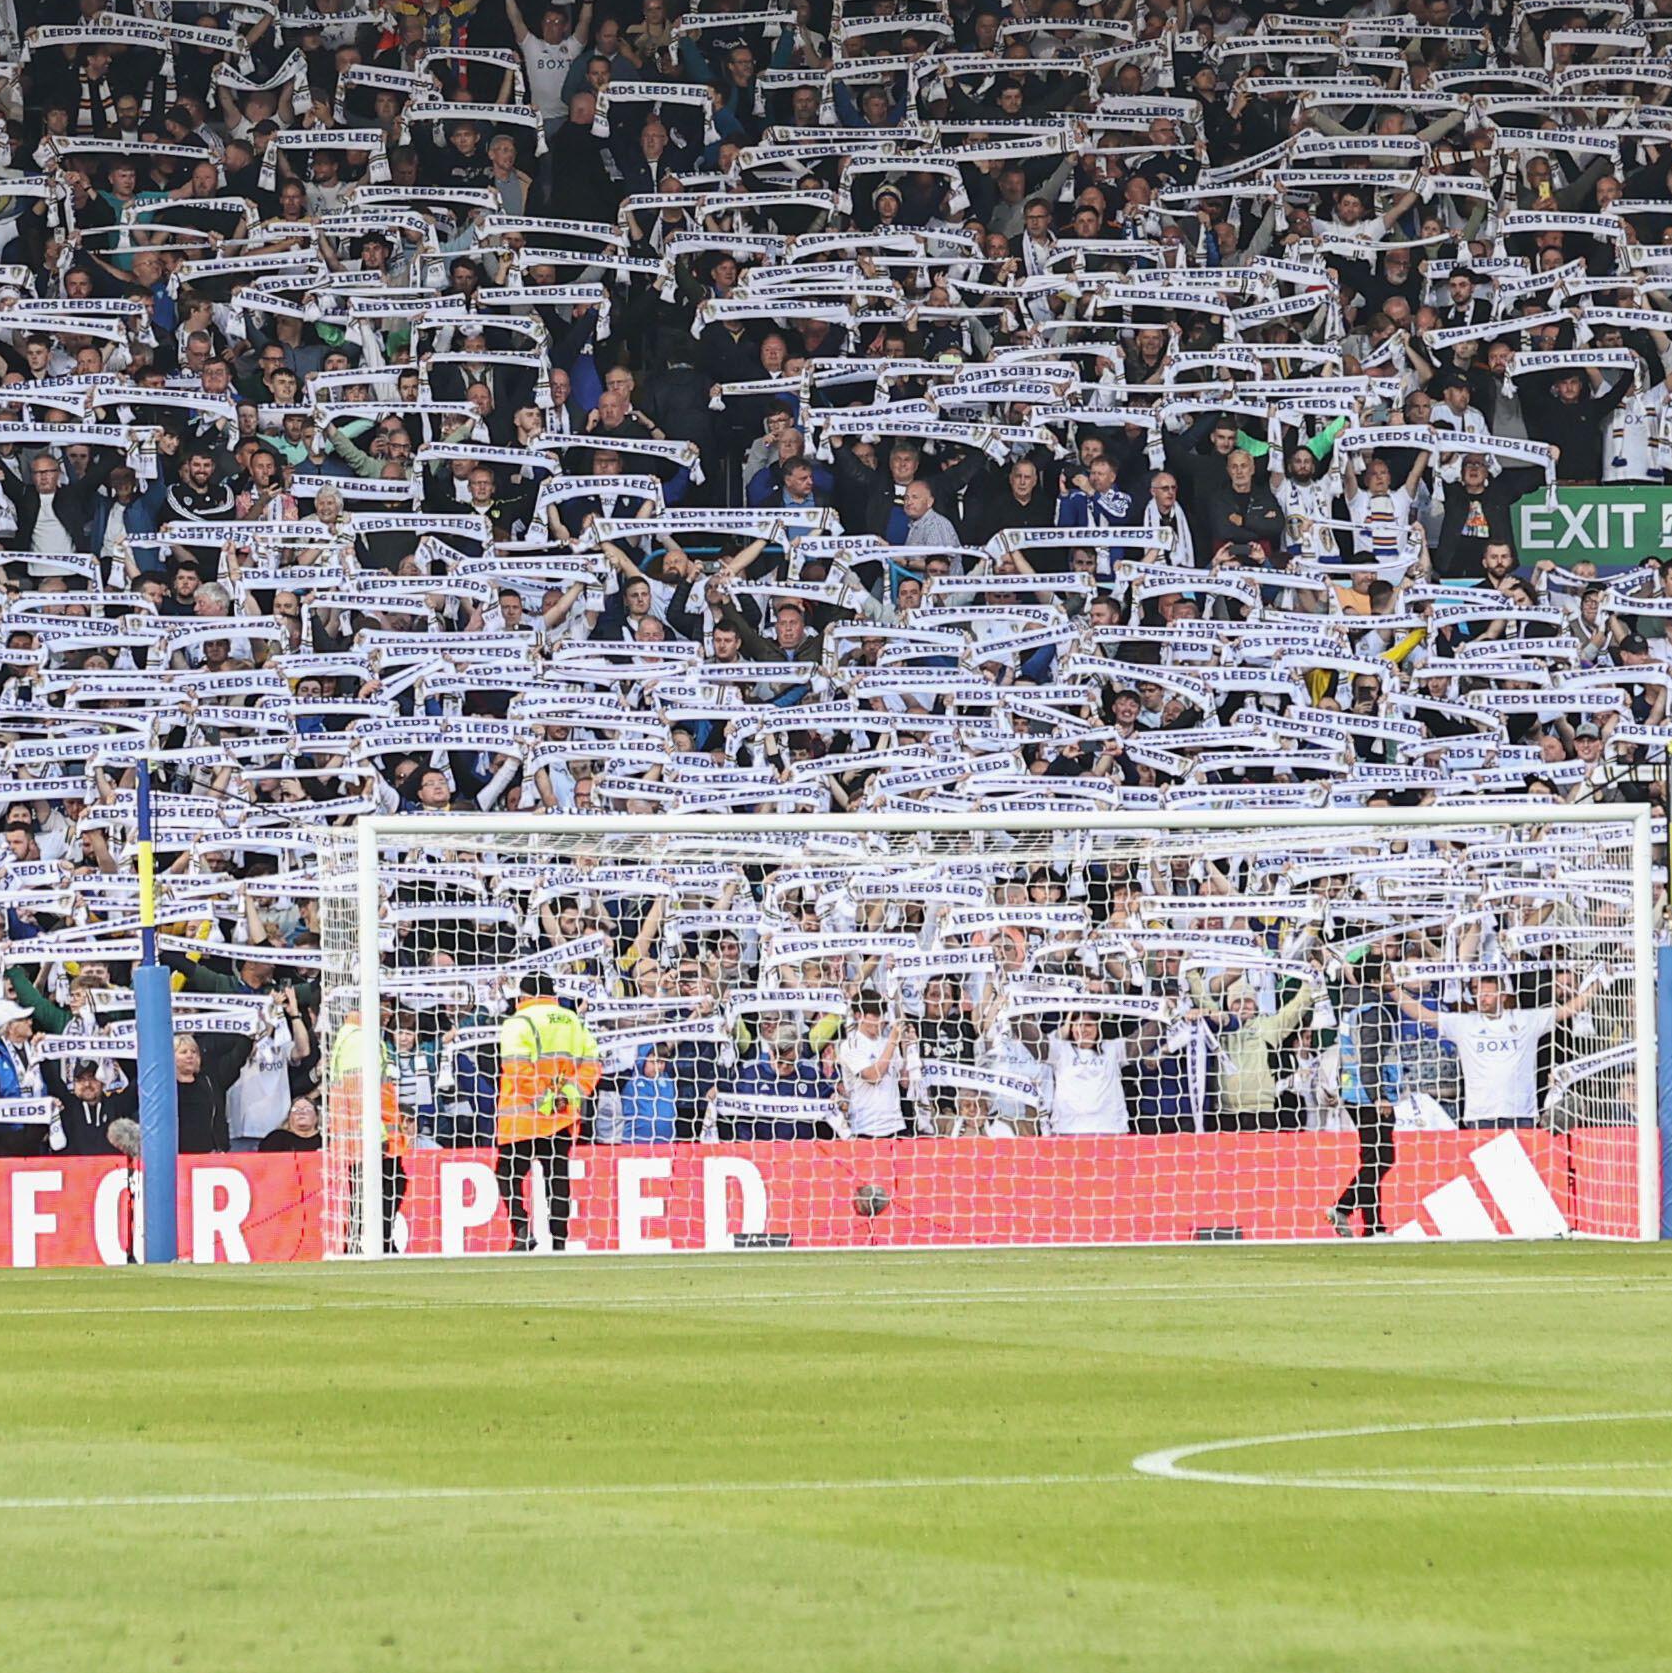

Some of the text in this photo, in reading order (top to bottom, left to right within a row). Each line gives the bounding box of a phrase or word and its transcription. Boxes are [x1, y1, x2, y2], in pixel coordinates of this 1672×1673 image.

[1498, 130, 1617, 149] LEEDS LEEDS LEEDS
[1297, 138, 1421, 155] LEEDS LEEDS LEEDS
[63, 299, 102, 310] LEEDS
[106, 301, 144, 313] LEEDS
[971, 383, 1051, 396] LEEDS LEEDS
[33, 424, 74, 435] LEEDS
[78, 425, 121, 436] LEEDS
[396, 519, 481, 532] LEEDS LEEDS
[1521, 503, 1646, 549] EXIT
[1025, 528, 1152, 541] LEEDS LEEDS LEEDS
[1487, 693, 1619, 705] LEEDS LEEDS LEEDS
[14, 742, 99, 758] LEEDS LEEDS
[880, 759, 1010, 787] LEEDS LEEDS LEEDS
[25, 780, 68, 792] LEEDS
[953, 910, 1040, 925] LEEDS LEEDS
[775, 937, 915, 955] LEEDS LEEDS LEEDS
[208, 1020, 251, 1032] LEEDS
[41, 1040, 134, 1052] LEEDS LEEDS
[1476, 1039, 1518, 1054] BOXT
[2, 1105, 45, 1117] LEEDS
